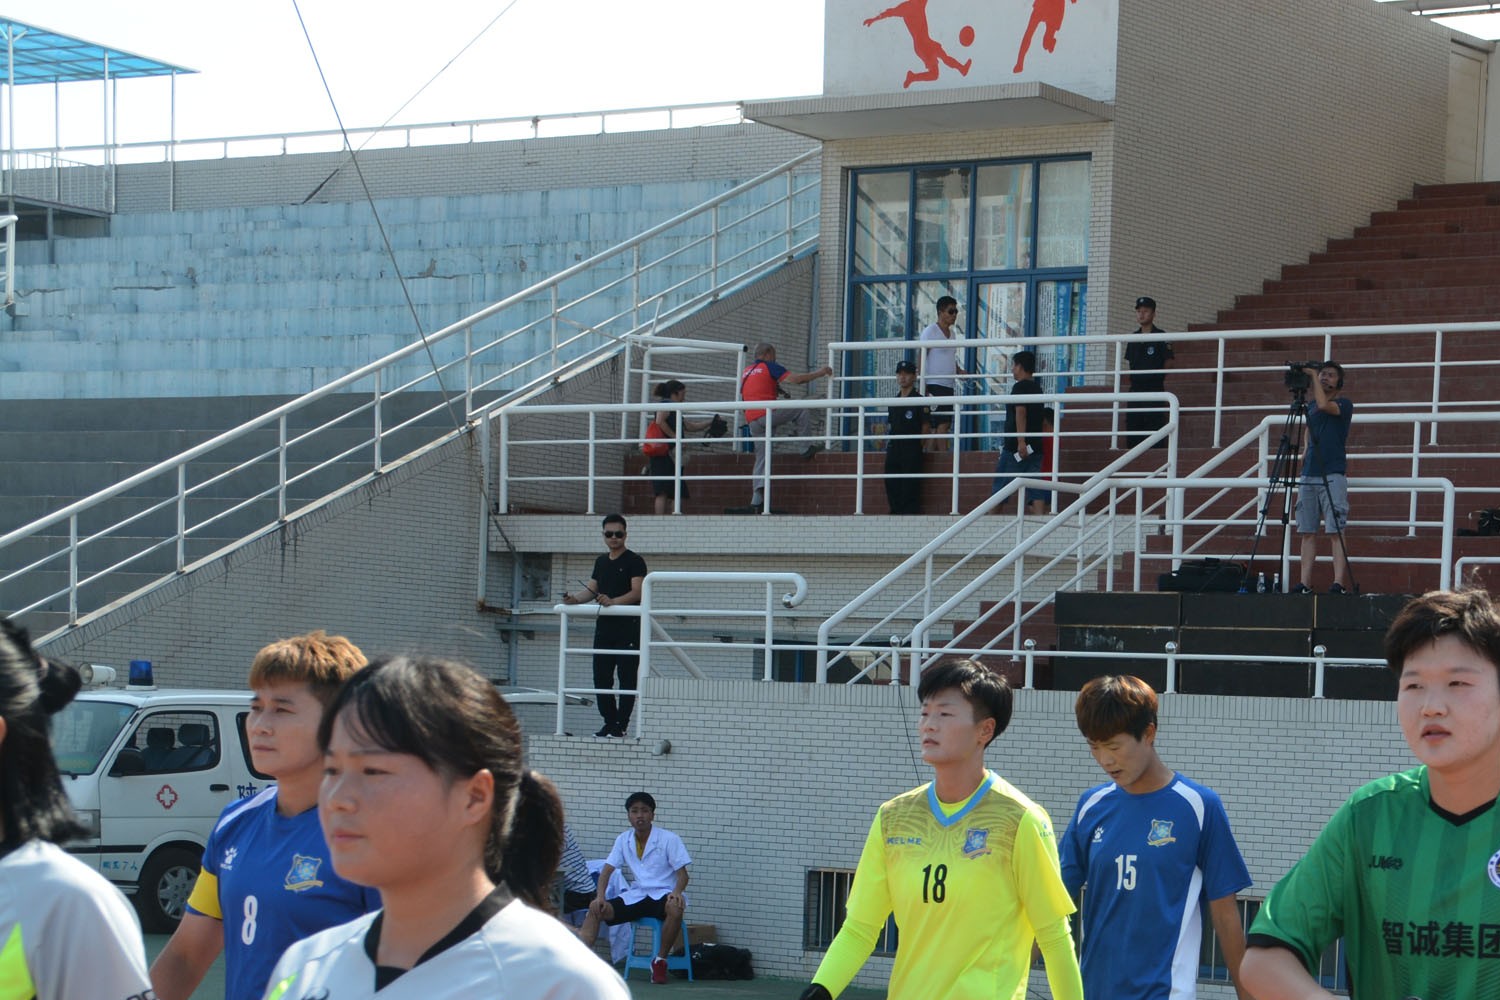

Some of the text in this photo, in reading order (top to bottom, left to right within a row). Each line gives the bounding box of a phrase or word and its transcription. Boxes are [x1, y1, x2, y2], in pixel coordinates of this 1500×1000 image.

[922, 863, 948, 904] 18
[1115, 854, 1138, 891] 15
[241, 895, 258, 946] 8
